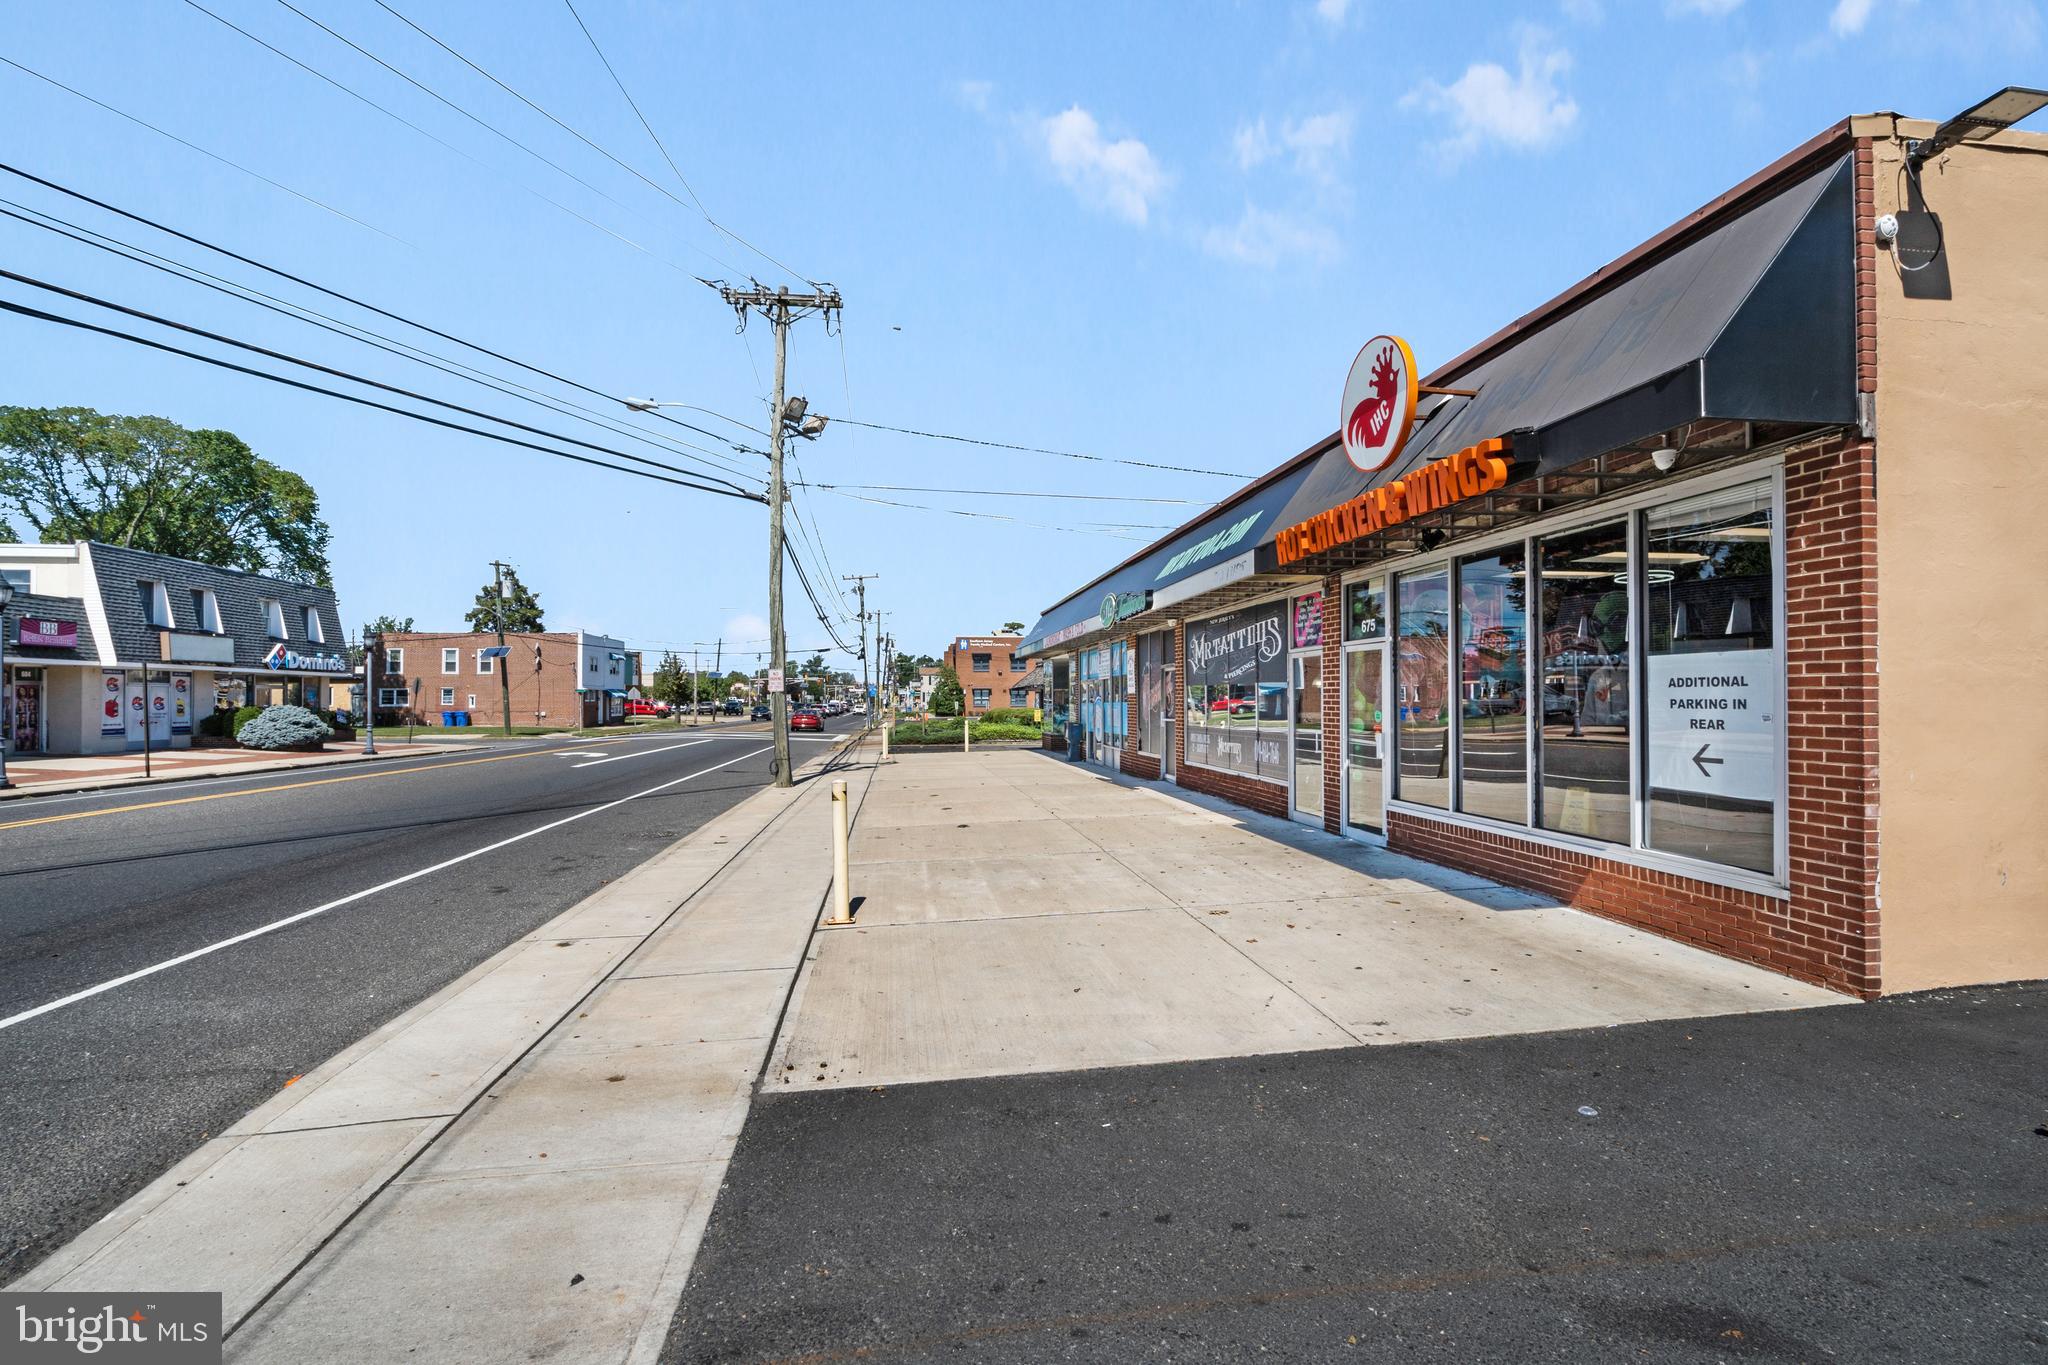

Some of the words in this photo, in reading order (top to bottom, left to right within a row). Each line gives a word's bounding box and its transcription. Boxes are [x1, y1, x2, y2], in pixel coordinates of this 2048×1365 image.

[1369, 399, 1390, 437] IHC
[1276, 523, 1306, 566] HOT
[1307, 488, 1383, 553] CHICKEN
[1383, 482, 1405, 525] &
[1403, 438, 1507, 518] WINGS
[1361, 619, 1376, 633] 675
[285, 651, 346, 671] Domino's
[1228, 660, 1256, 679] PIERCINGS
[1668, 675, 1748, 688] ADDITIONAL
[1670, 698, 1728, 710] PARKING
[1732, 698, 1747, 710] IN
[1690, 719, 1725, 730] REAR
